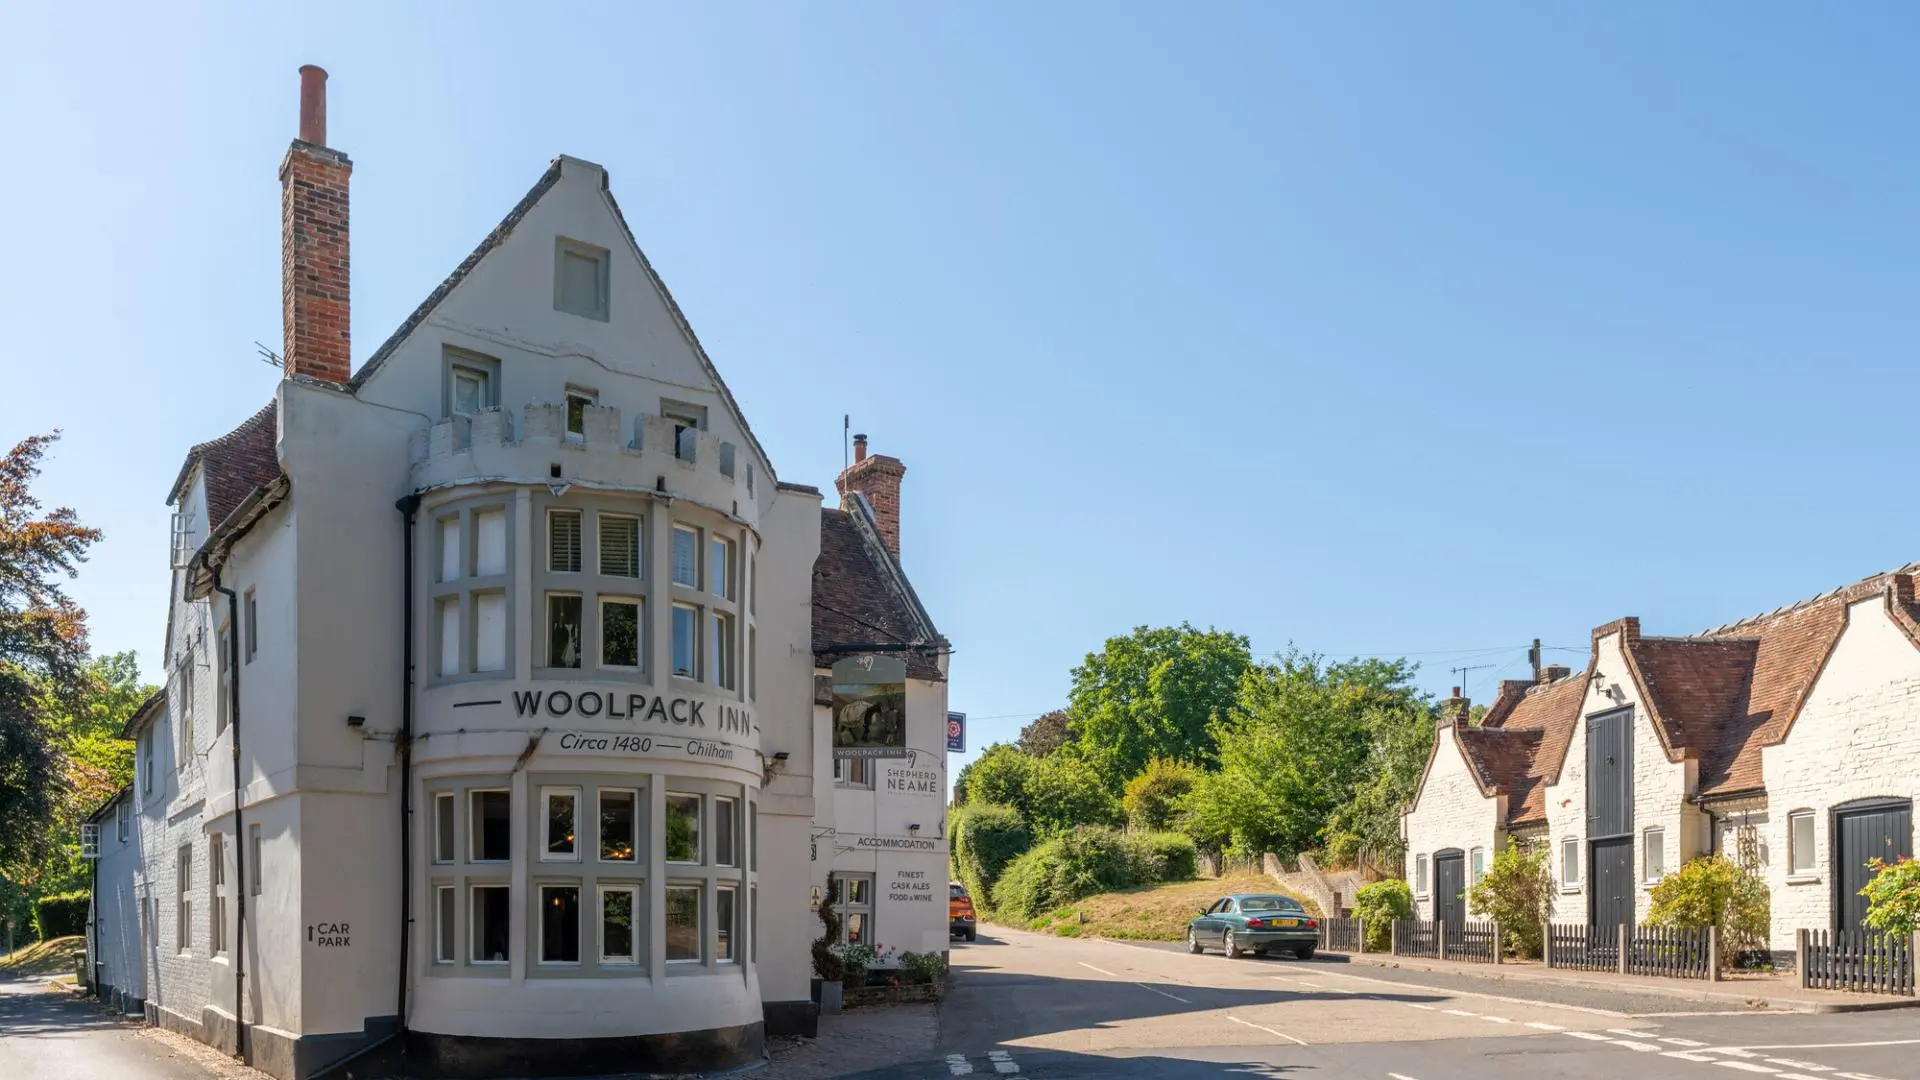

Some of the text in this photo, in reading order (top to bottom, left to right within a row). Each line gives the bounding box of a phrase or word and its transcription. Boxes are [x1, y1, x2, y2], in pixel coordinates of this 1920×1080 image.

[512, 690, 750, 737] WOOLPACK INN
[560, 733, 734, 760] Circa 1480 Chilham
[837, 749, 883, 757] WOOLPACK
[887, 768, 937, 781] SHEPHERD
[887, 779, 936, 793] NEAME
[857, 837, 935, 850] ACCOMMODATION
[897, 870, 925, 879] FINEST
[891, 881, 930, 890] CASK ALES
[914, 894, 932, 902] WINE
[317, 922, 350, 935] CAR
[317, 936, 351, 947] PARK
